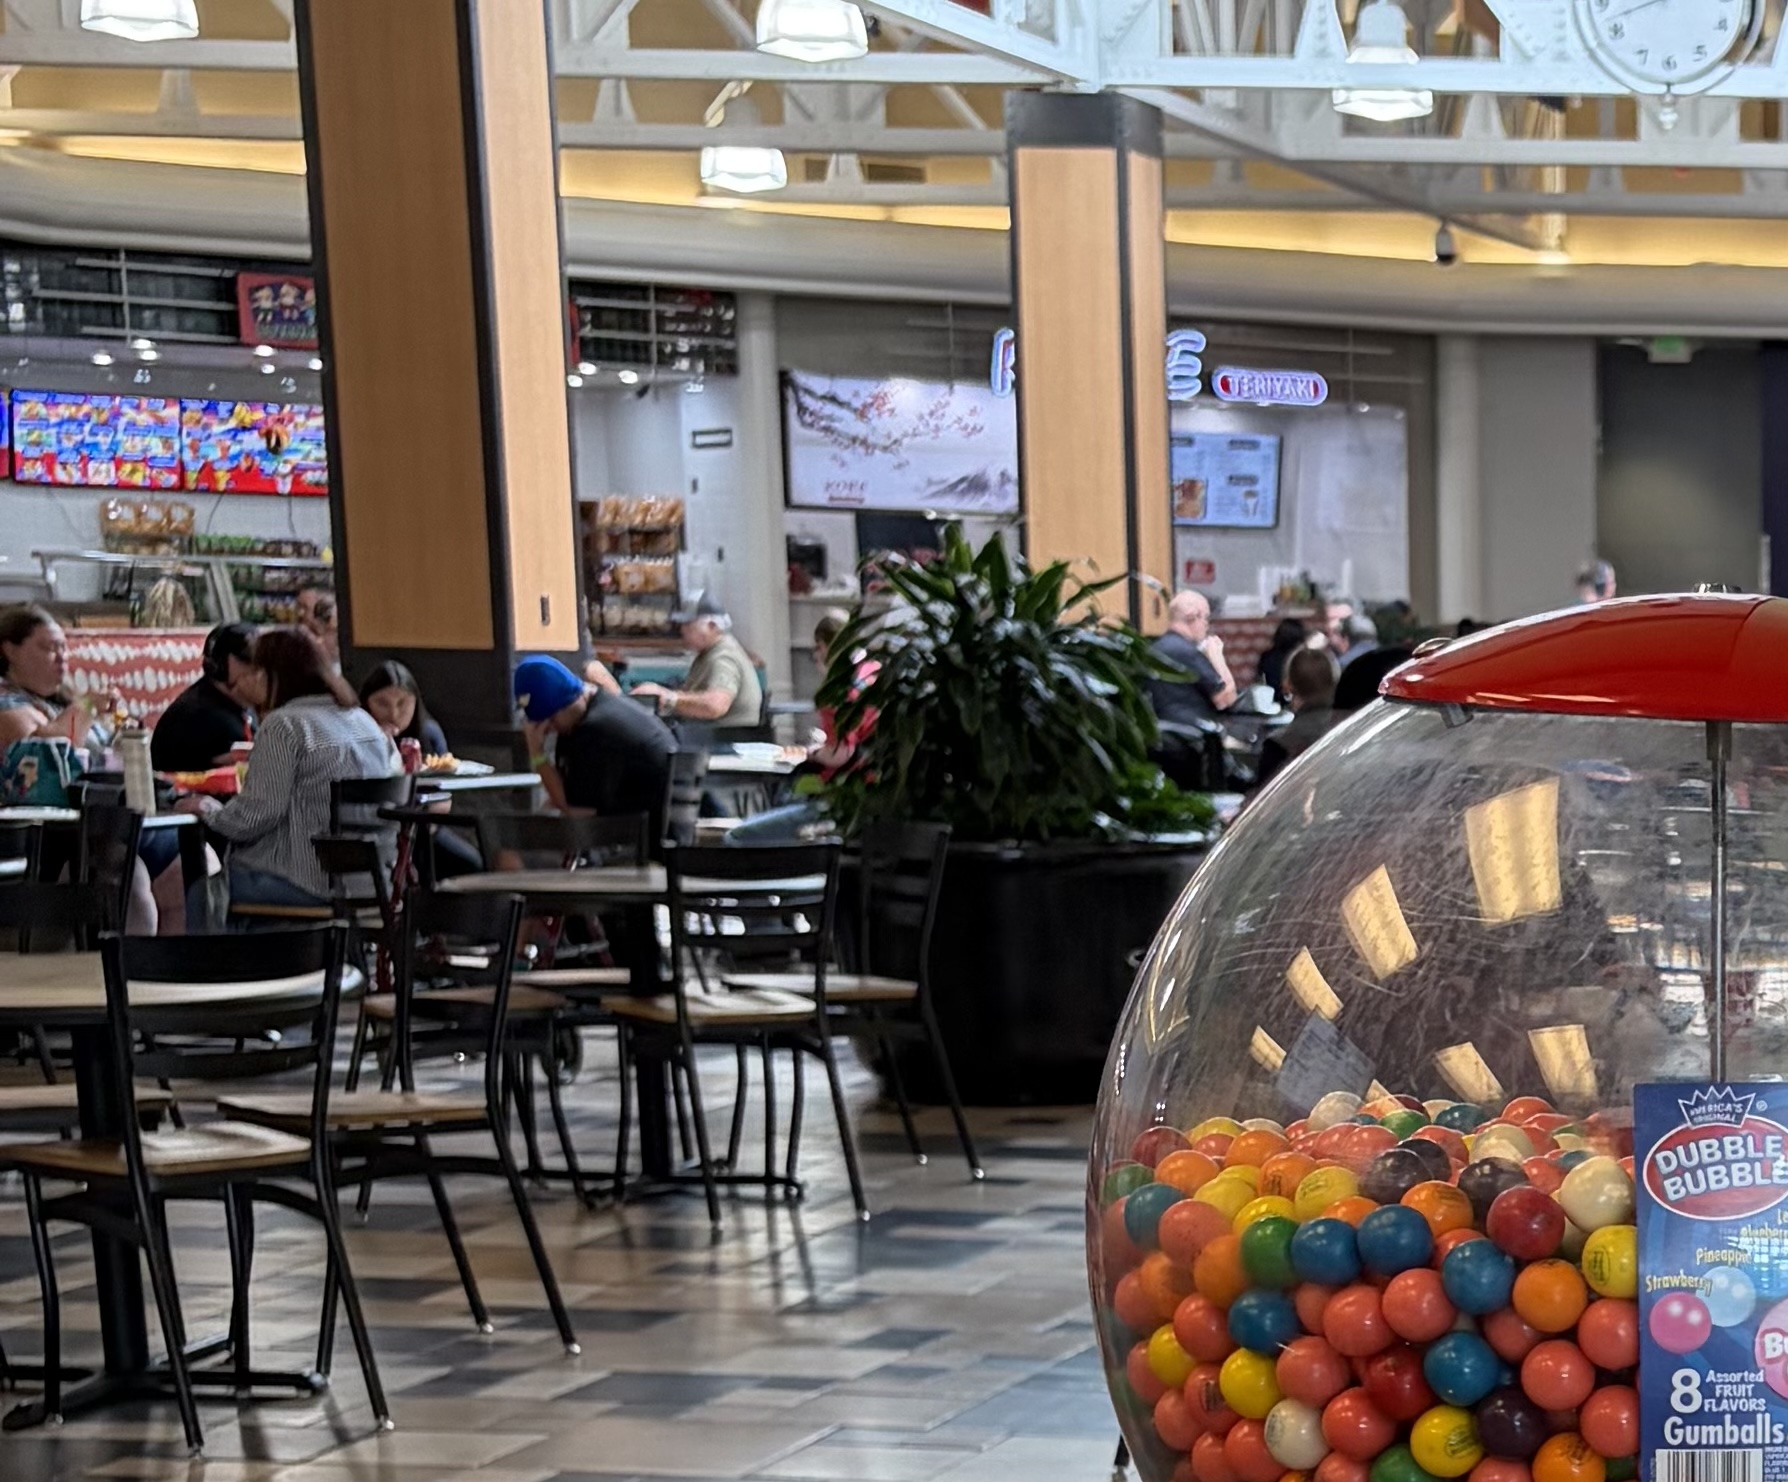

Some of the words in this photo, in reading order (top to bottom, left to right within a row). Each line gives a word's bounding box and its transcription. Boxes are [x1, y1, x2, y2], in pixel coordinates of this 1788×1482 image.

[1608, 21, 1625, 40] 8
[1713, 16, 1728, 32] 4
[1635, 48, 1649, 66] 7
[1692, 44, 1708, 62] 5
[1661, 54, 1678, 71] 6
[1228, 373, 1316, 400] TERIYAKI
[1654, 1135, 1784, 1176] DUBBLE
[1705, 1369, 1765, 1383] Assorted
[1670, 1368, 1703, 1413] 8
[1715, 1384, 1755, 1398] FRUIT
[1703, 1398, 1767, 1412] FLAVORS
[1664, 1412, 1785, 1446] Gumballs
